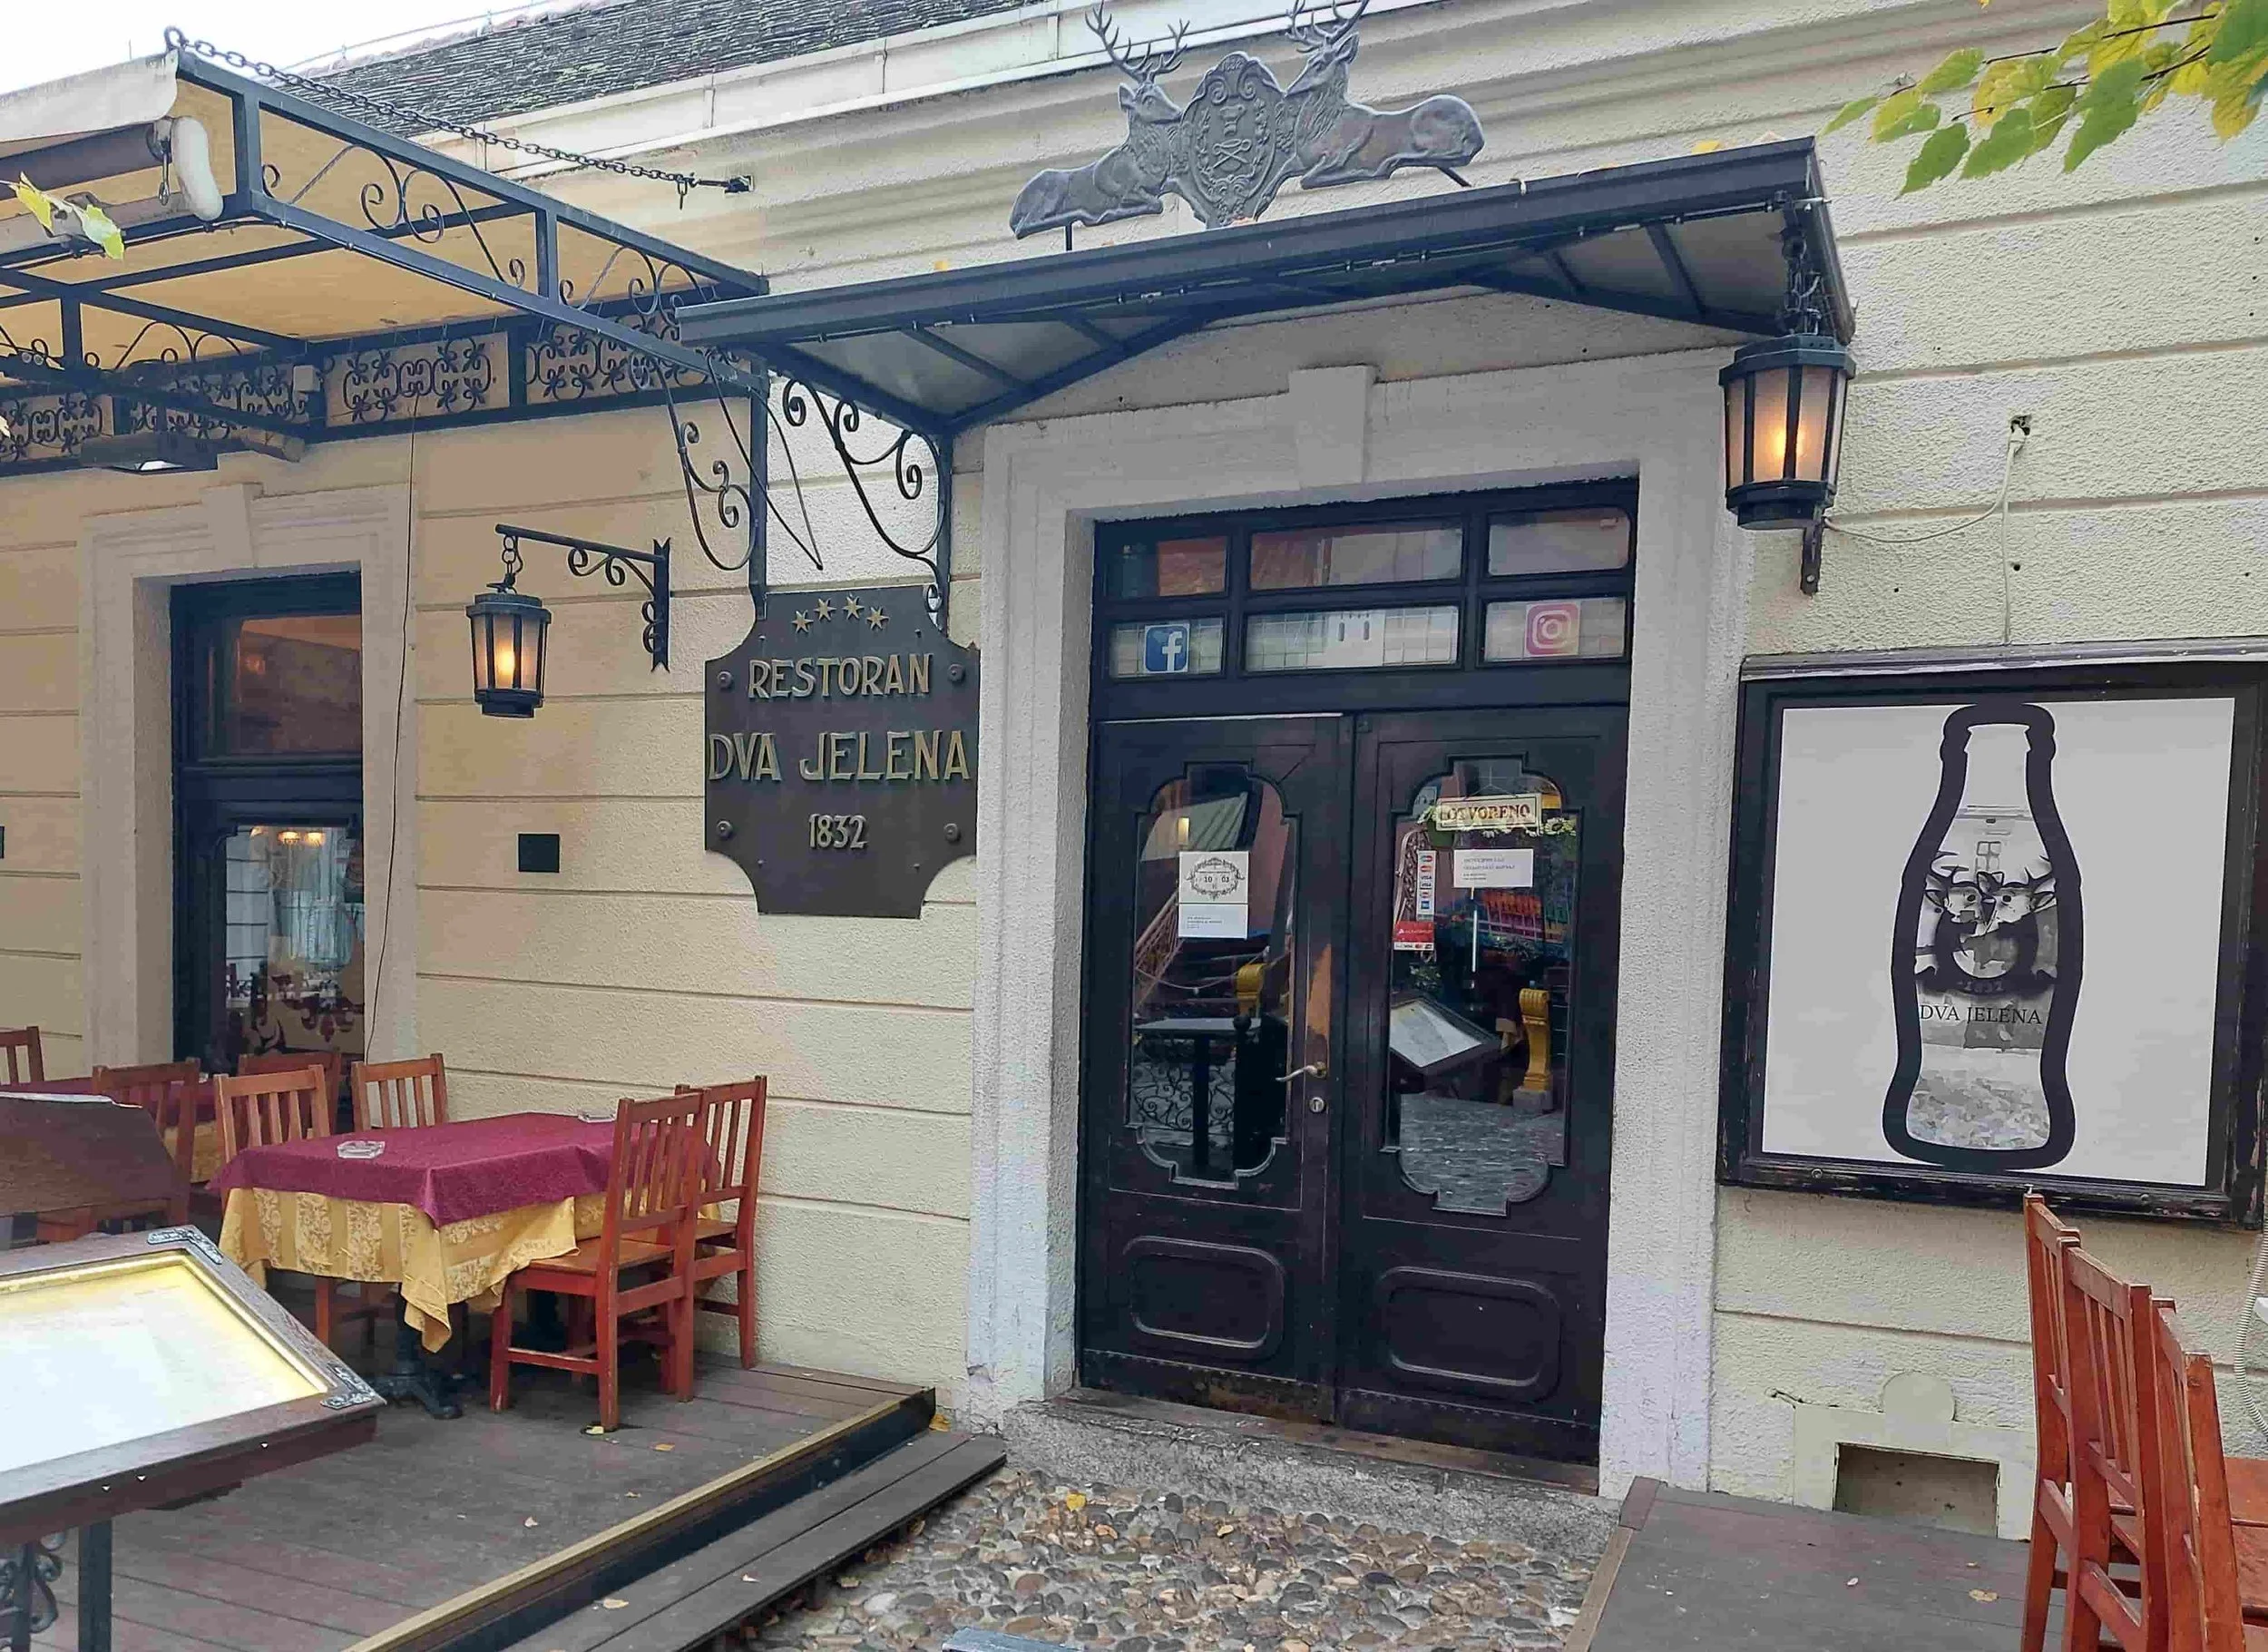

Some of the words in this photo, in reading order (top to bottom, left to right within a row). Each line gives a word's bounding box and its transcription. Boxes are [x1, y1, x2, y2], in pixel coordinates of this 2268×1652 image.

[747, 652, 934, 699] RESTORAN
[708, 732, 782, 782] DVA
[798, 729, 970, 782] JELENA
[808, 814, 869, 850] 1832
[1919, 1004, 1960, 1021] DVA
[1966, 1006, 2042, 1025] JELENA
